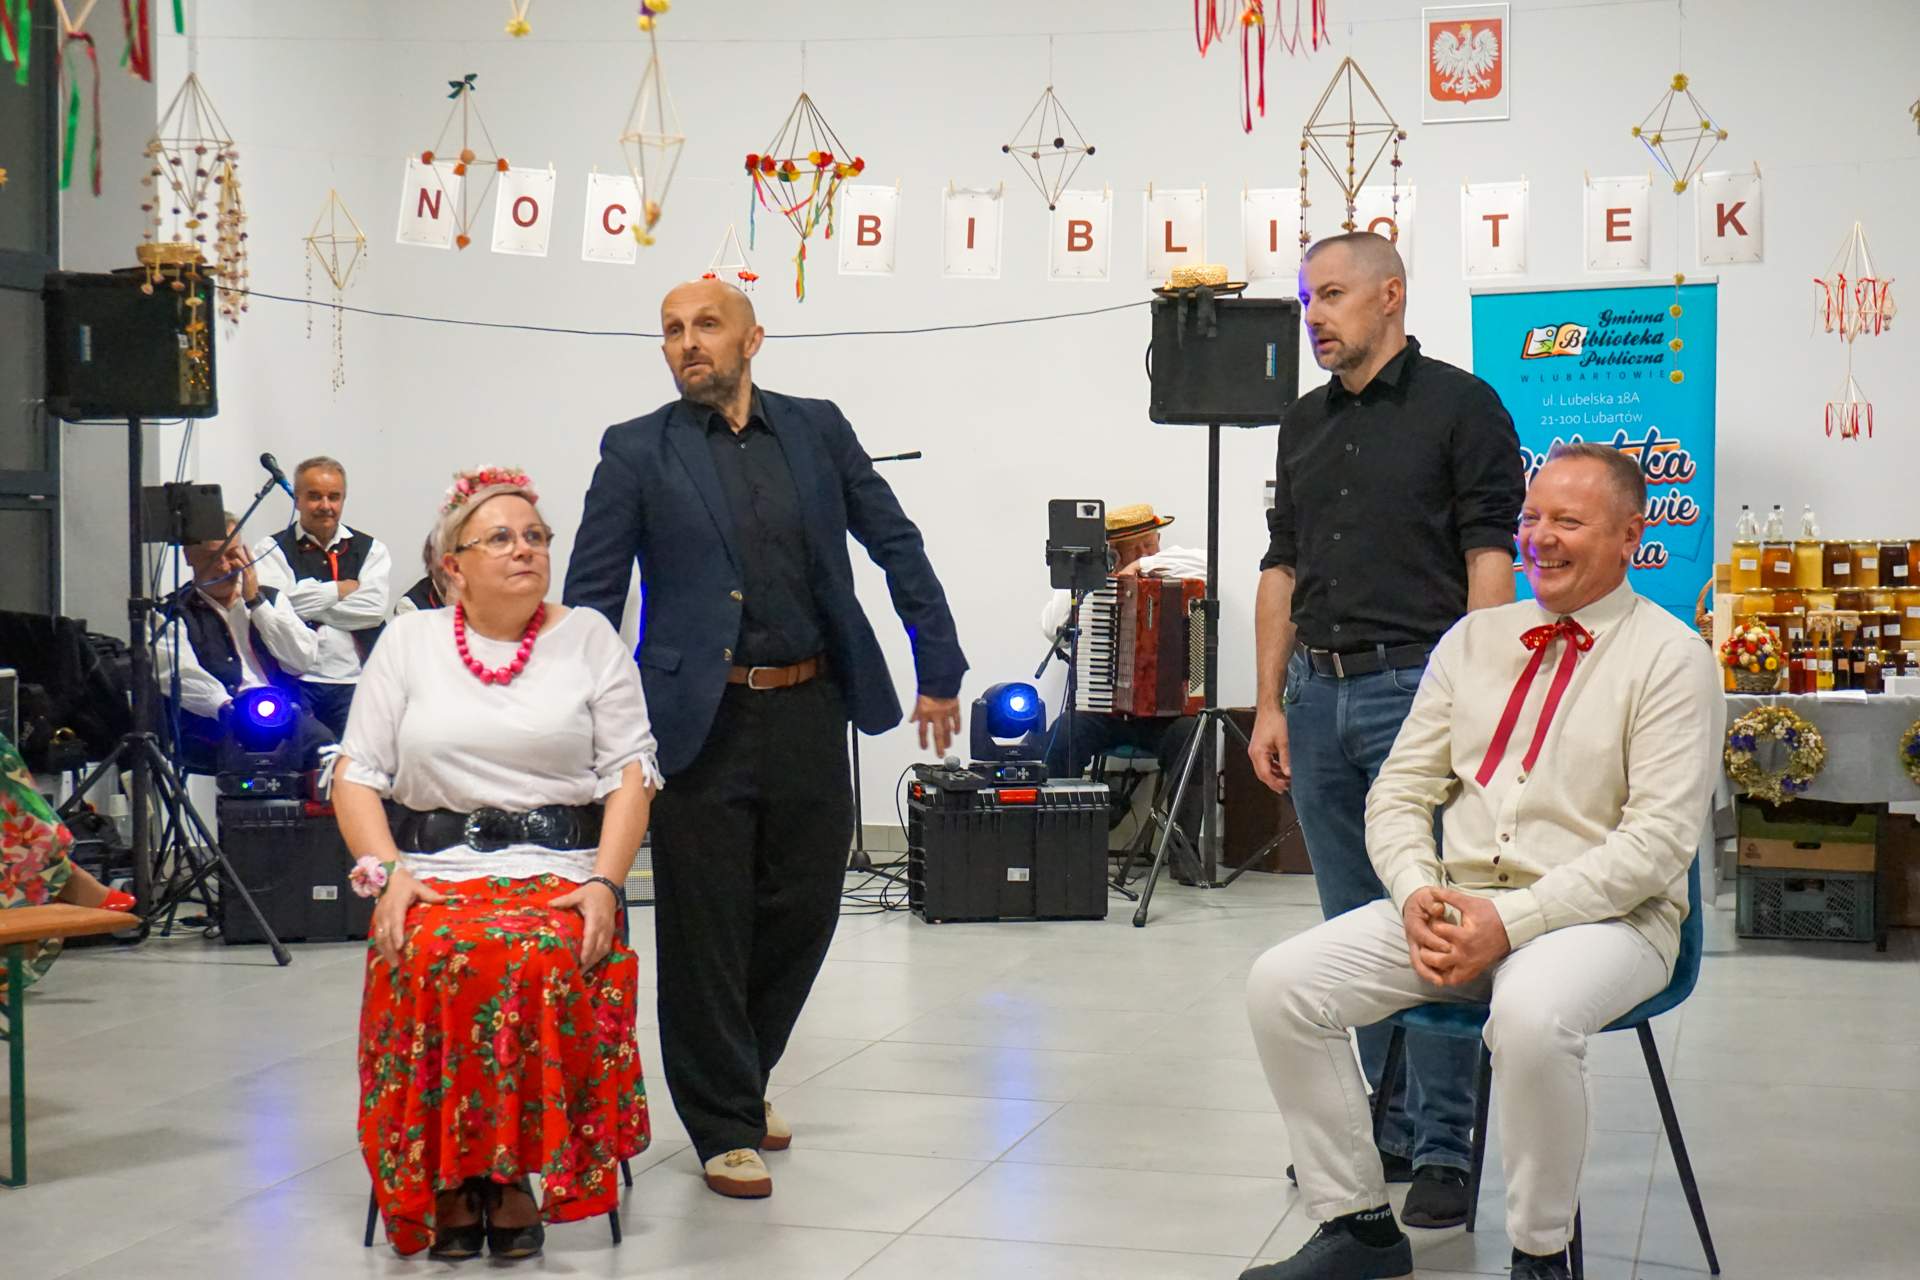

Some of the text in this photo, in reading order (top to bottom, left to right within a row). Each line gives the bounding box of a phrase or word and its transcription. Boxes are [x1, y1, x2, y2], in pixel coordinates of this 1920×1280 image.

[417, 187, 628, 236] NOC
[1598, 309, 1665, 327] Gminna
[1559, 328, 1664, 349] Biblioteka
[1579, 350, 1665, 368] Publiczna
[1520, 370, 1665, 383] W LUBARTOWIE
[1560, 392, 1614, 406] Lubelska
[1617, 391, 1640, 405] 18A
[1540, 411, 1643, 425] 21-100 Lubartów
